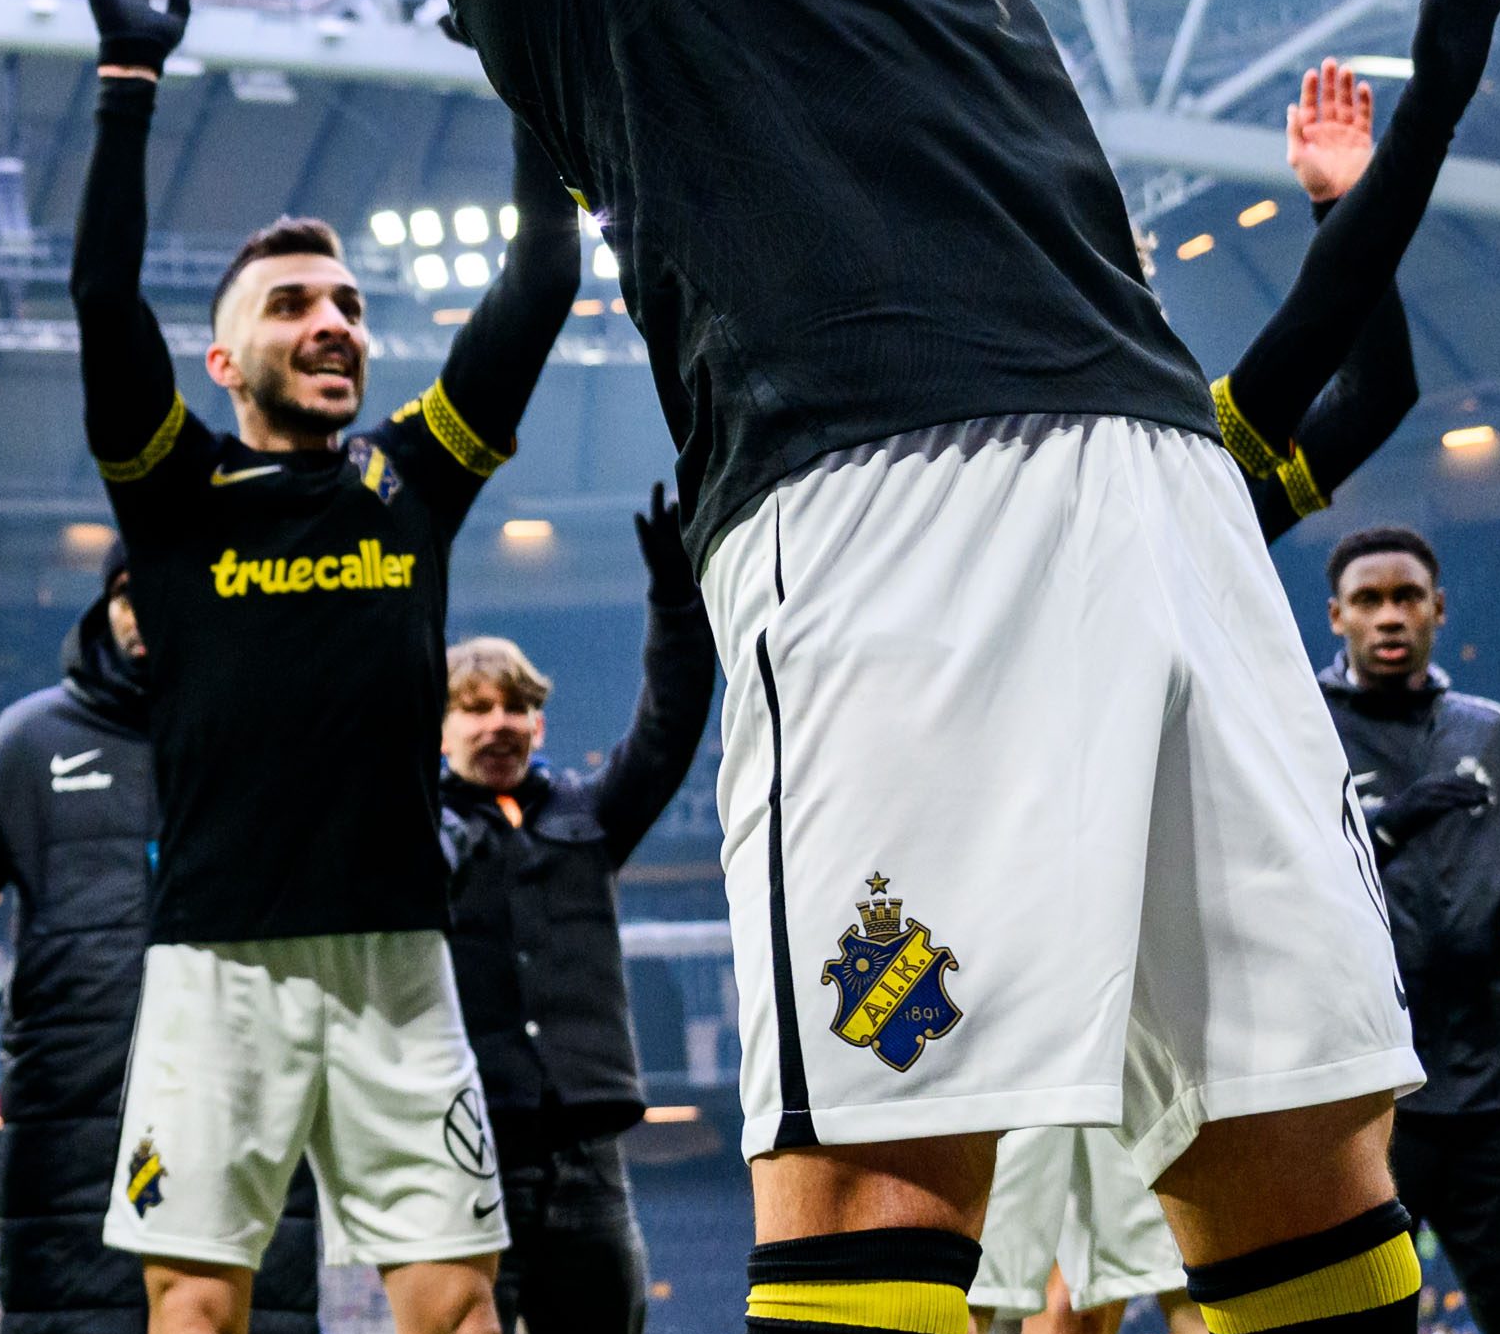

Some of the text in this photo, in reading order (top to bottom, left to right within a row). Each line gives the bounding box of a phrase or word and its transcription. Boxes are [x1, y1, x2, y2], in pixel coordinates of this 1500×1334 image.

[210, 538, 416, 599] truecaller
[861, 955, 926, 1029] A.I.K.
[904, 1005, 941, 1022] 1891
